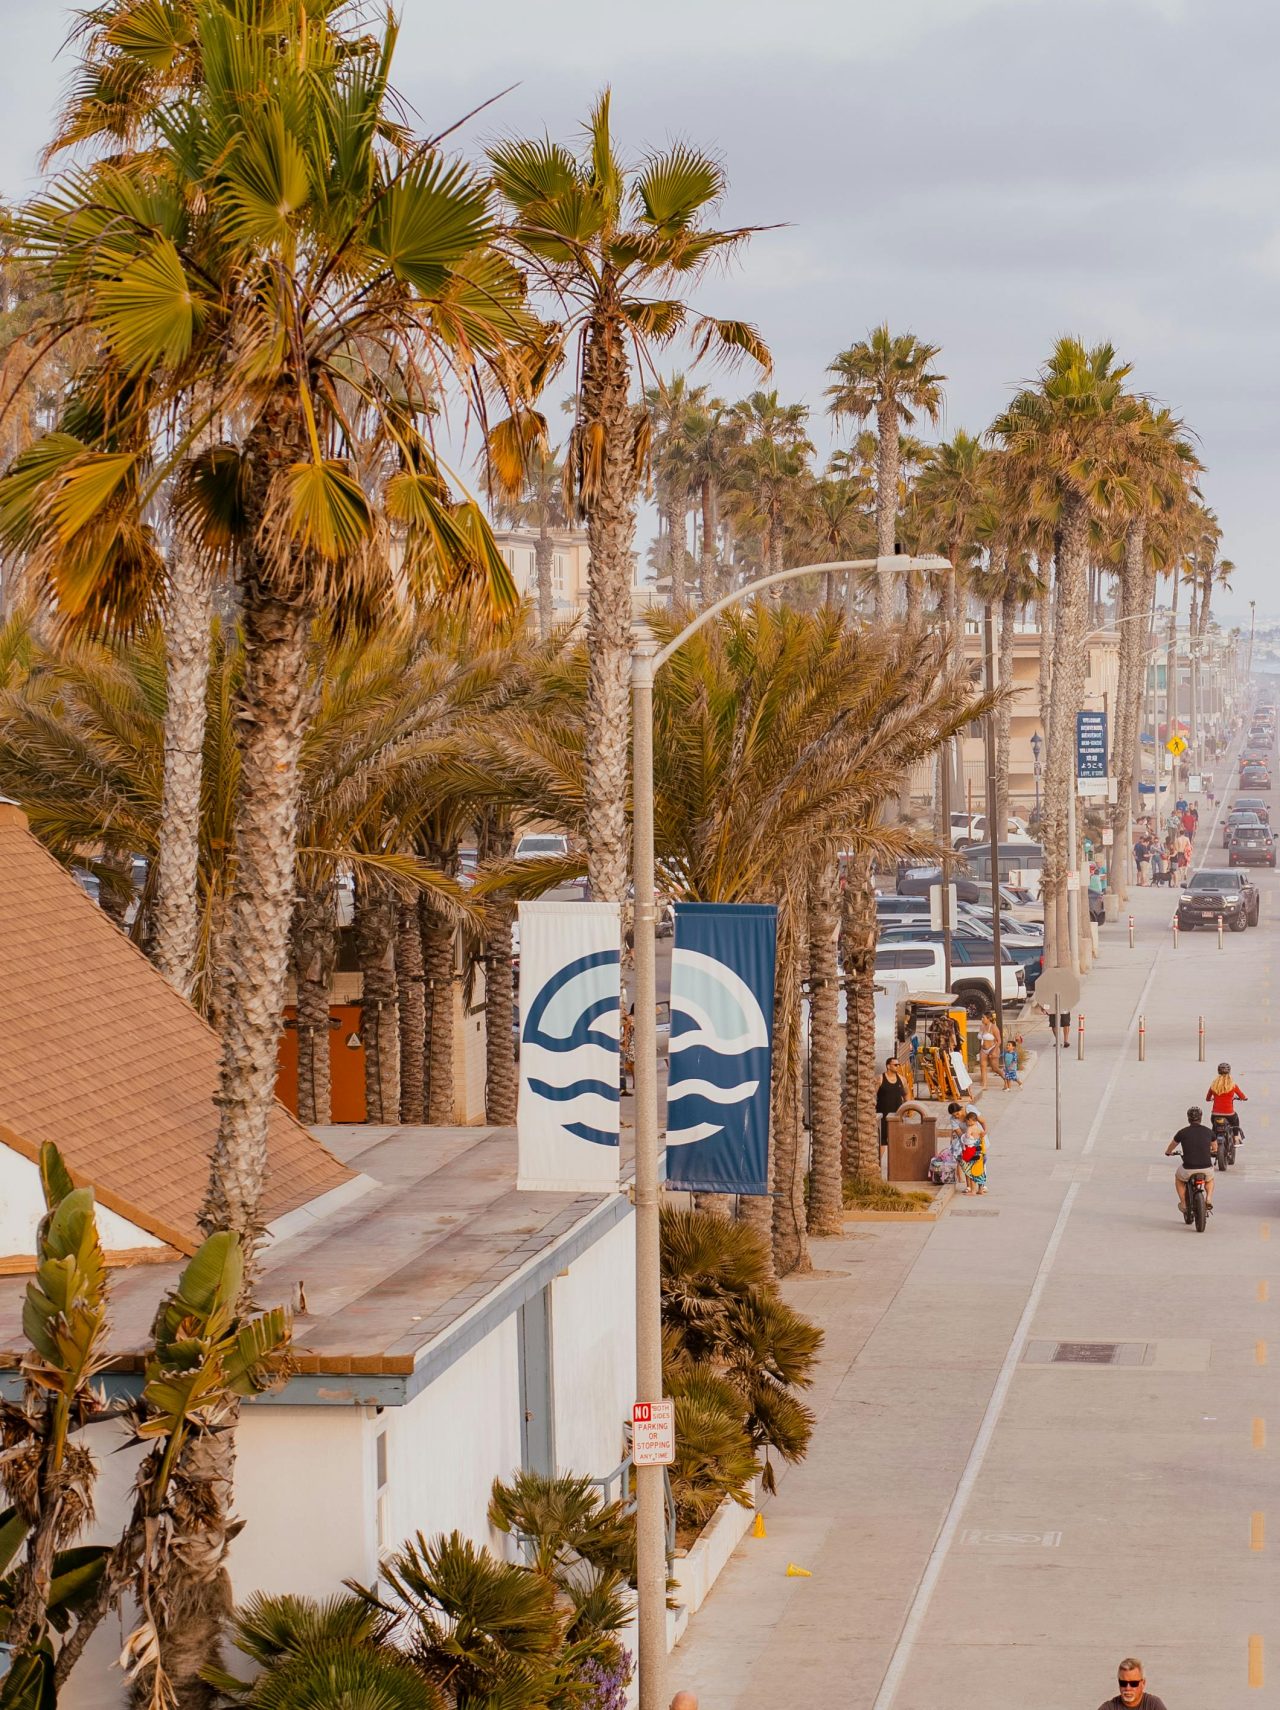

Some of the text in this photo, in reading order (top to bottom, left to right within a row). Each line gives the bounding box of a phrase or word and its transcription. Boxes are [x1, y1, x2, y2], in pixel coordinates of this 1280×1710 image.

[634, 1405, 649, 1420] NO
[638, 1423, 668, 1431] PARKING
[648, 1432, 658, 1440] OR
[637, 1441, 671, 1450] STOPPING
